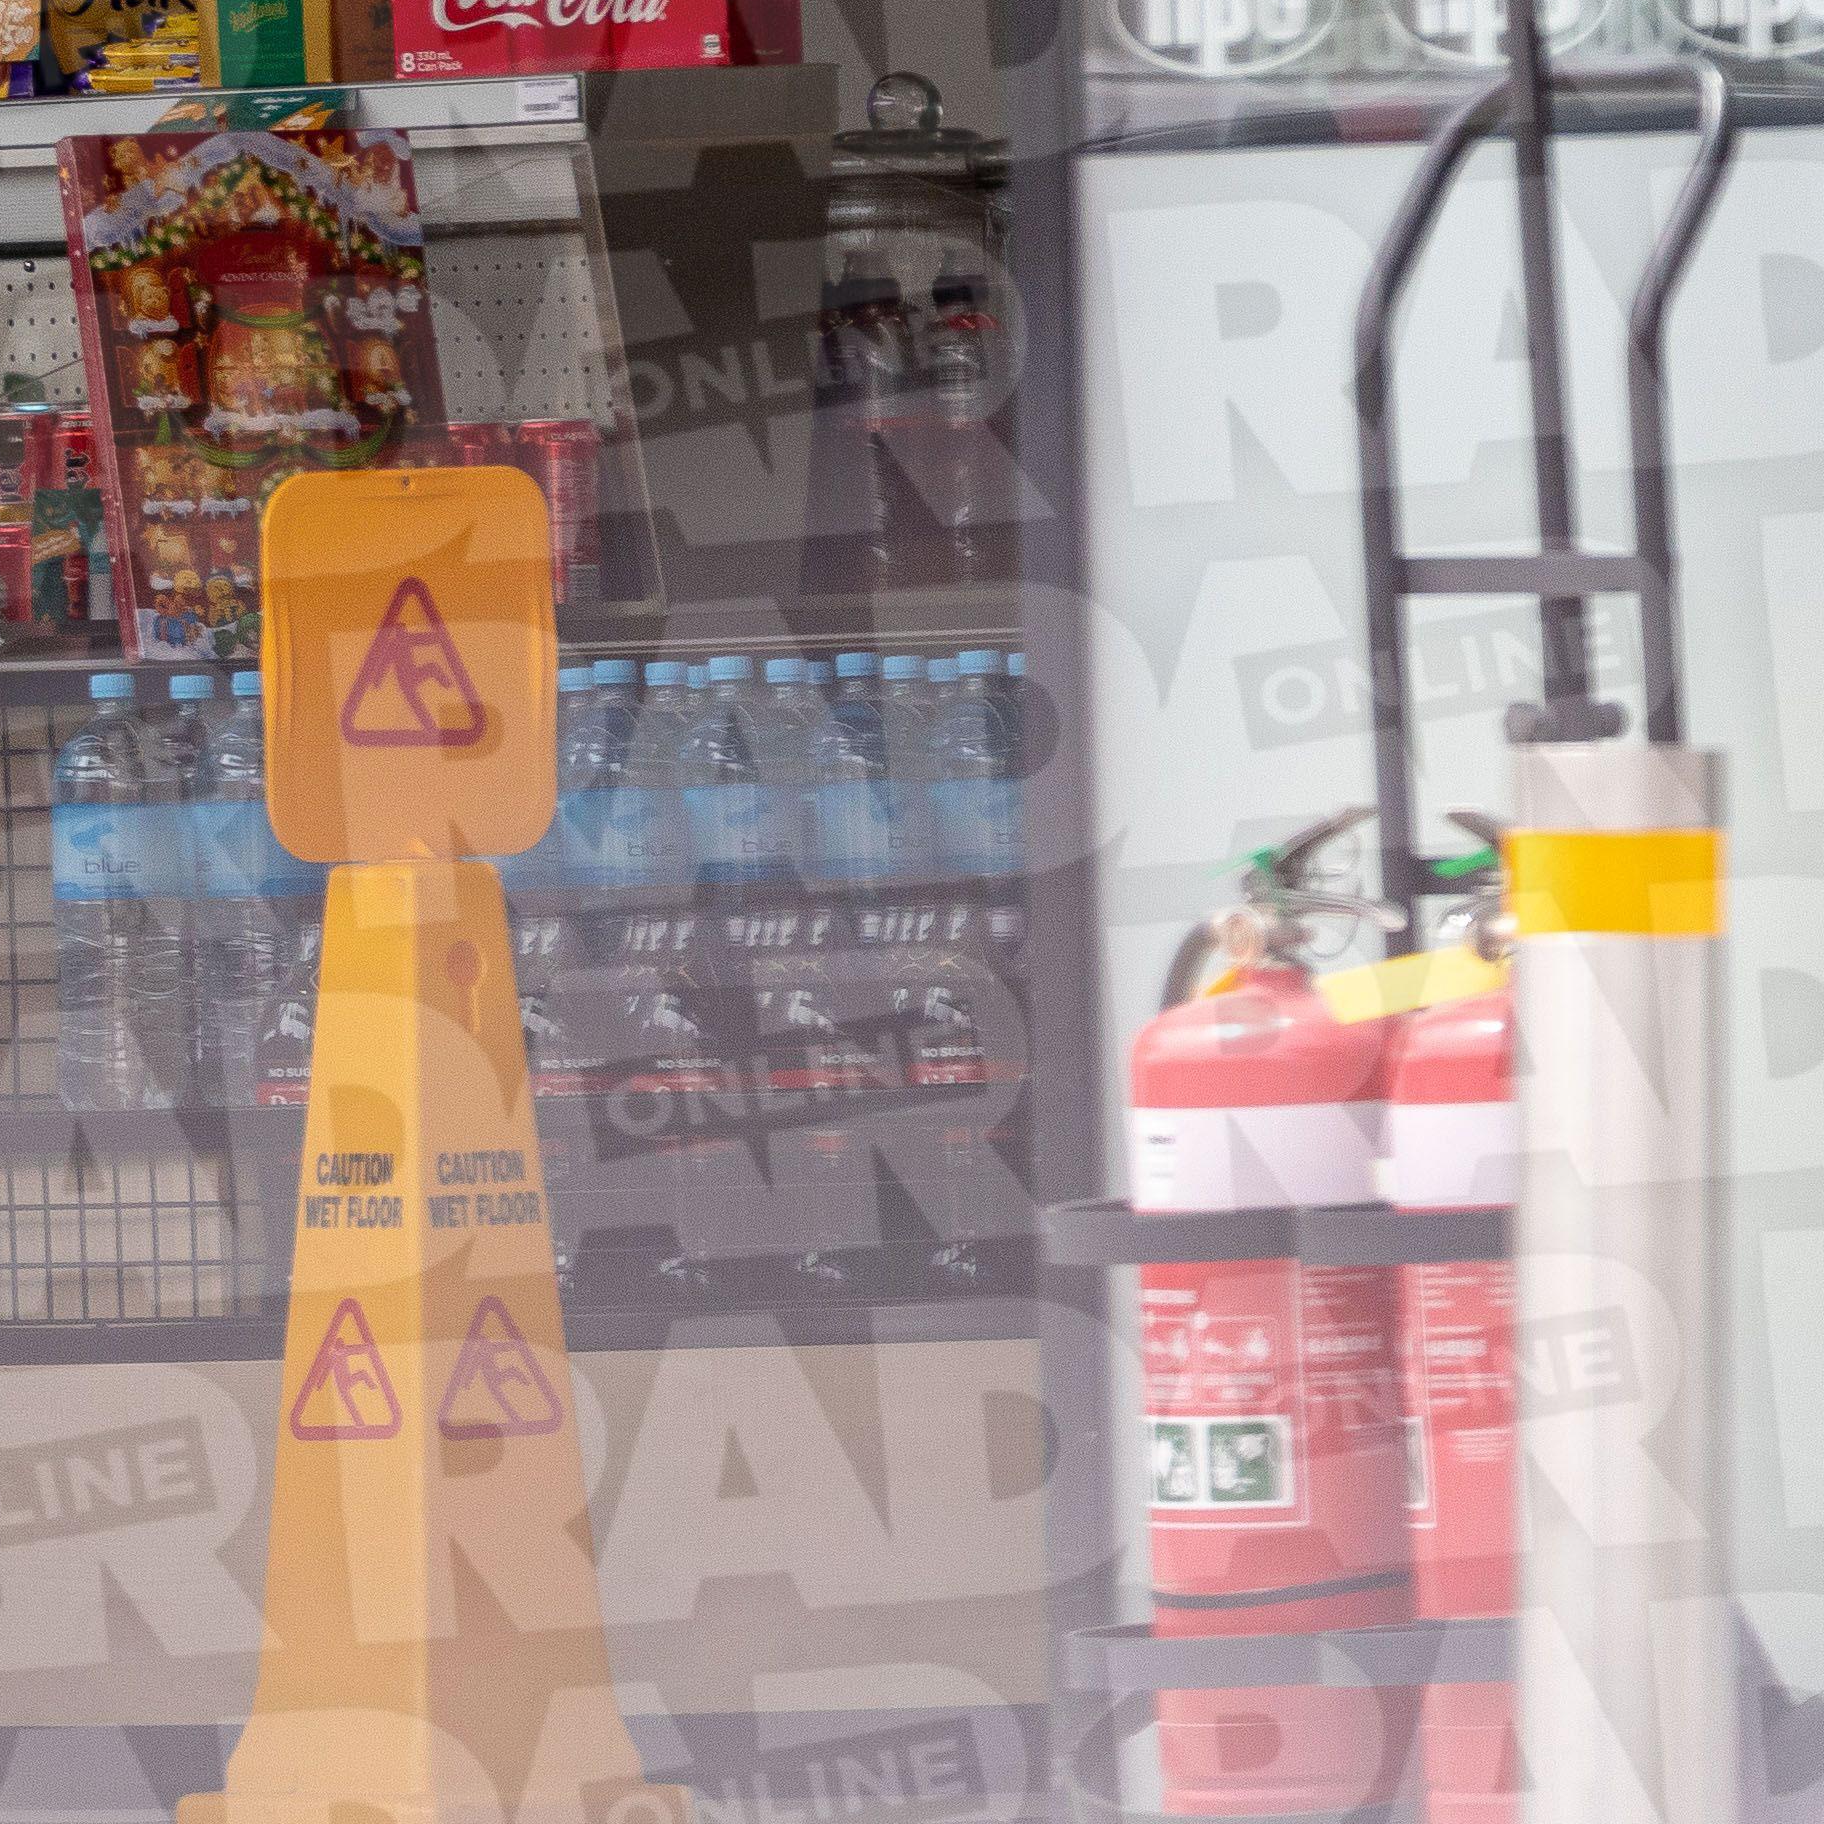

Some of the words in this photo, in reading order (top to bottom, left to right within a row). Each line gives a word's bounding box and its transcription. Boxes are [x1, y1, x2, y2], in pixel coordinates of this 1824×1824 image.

[315, 1152, 395, 1186] CAUTION
[436, 1149, 527, 1186] CAUTION
[305, 1195, 342, 1229] WET
[346, 1194, 403, 1229] FLOOR
[427, 1195, 469, 1229] WET
[475, 1191, 544, 1226] FLOOR
